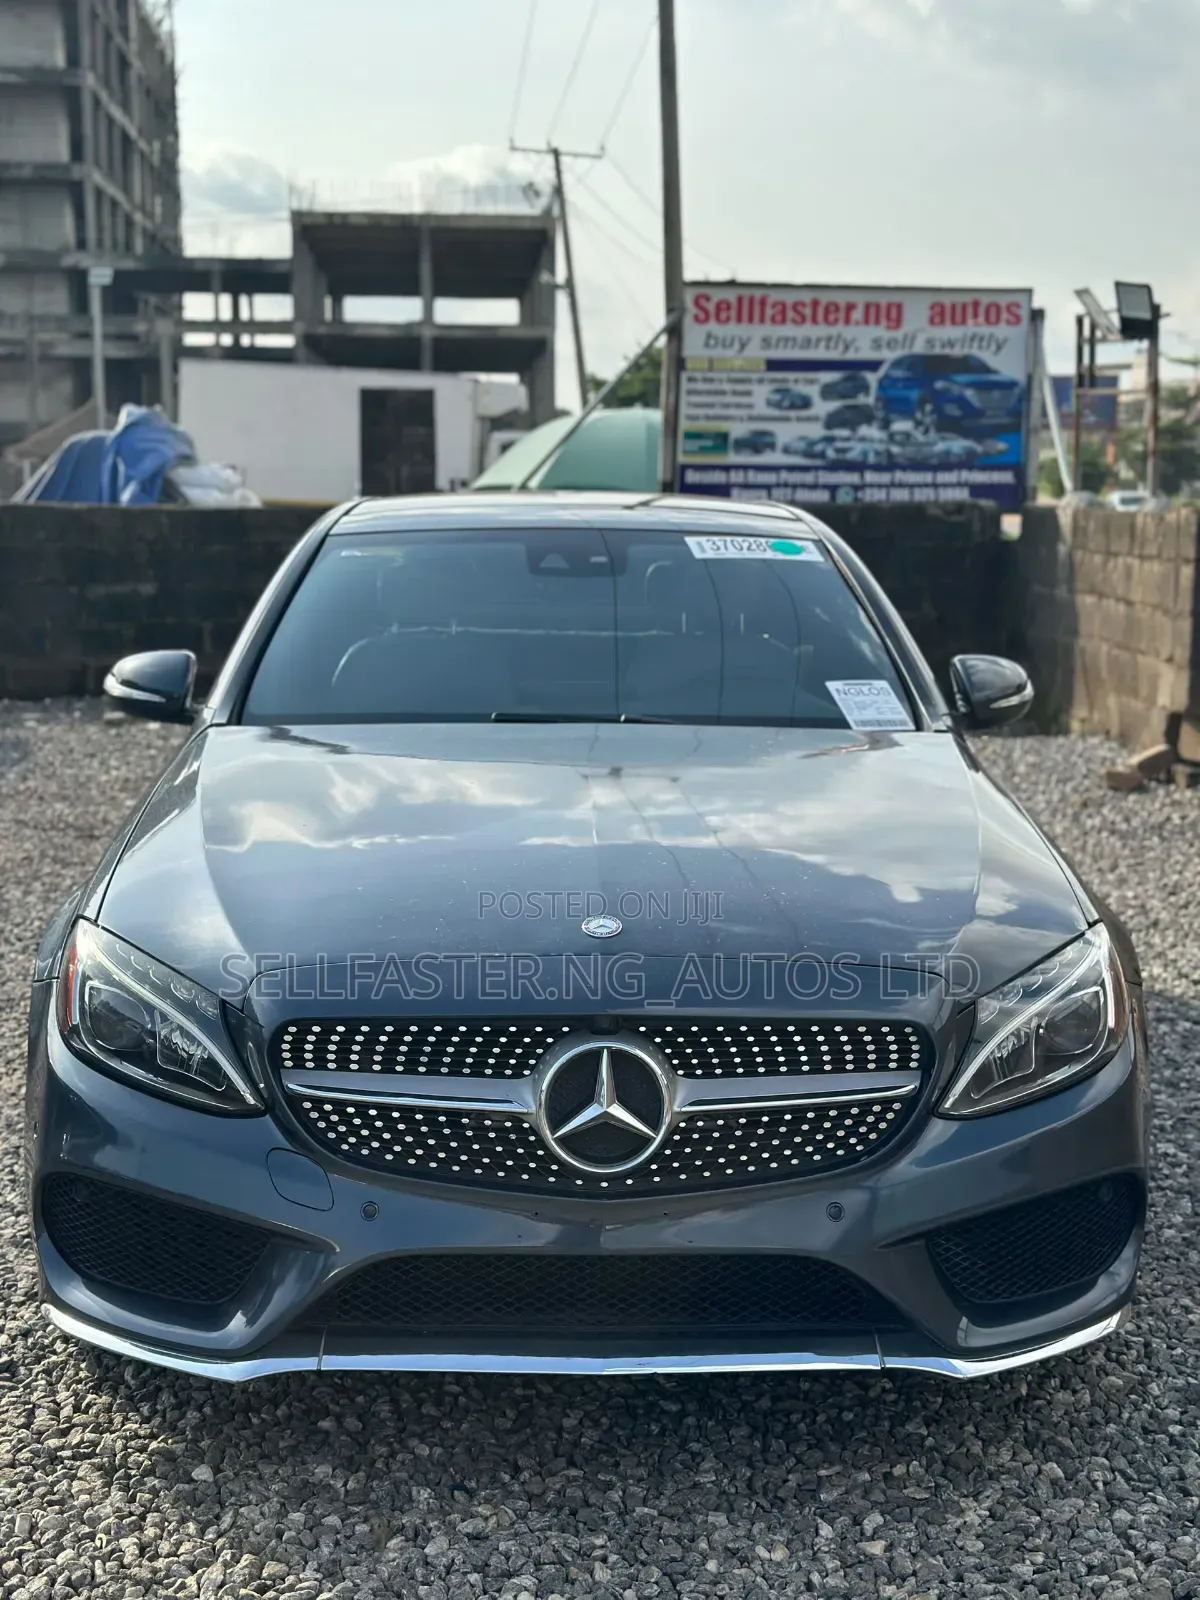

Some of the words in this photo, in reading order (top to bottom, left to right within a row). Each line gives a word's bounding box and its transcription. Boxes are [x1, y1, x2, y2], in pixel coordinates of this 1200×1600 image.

[692, 294, 904, 330] Sellfaster.ng
[928, 298, 1023, 327] autos
[703, 331, 749, 353] buy
[760, 332, 860, 355] smartly,
[869, 332, 918, 351] sell
[923, 332, 1010, 356] swiftly
